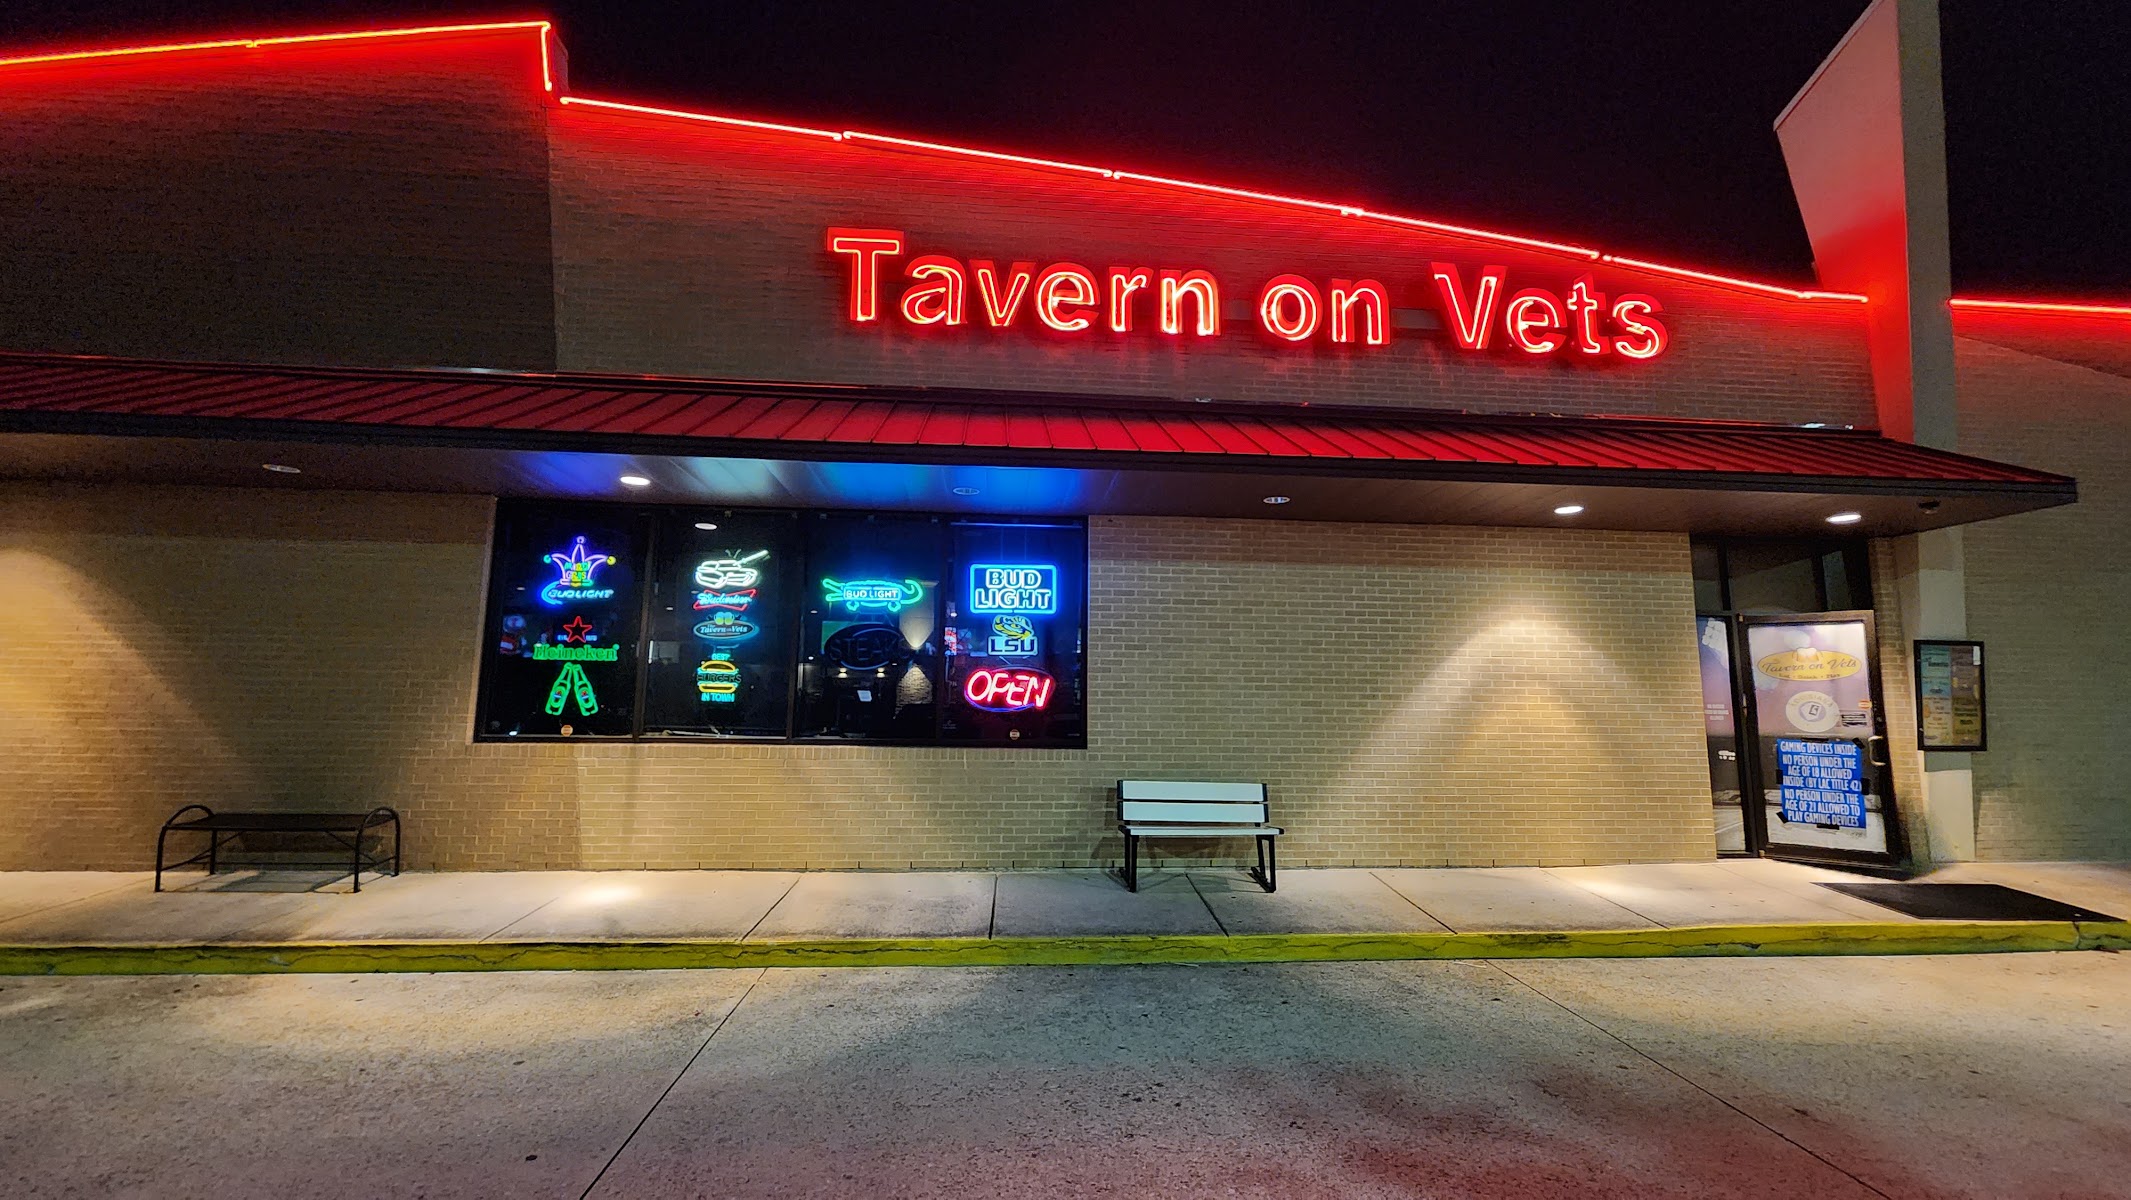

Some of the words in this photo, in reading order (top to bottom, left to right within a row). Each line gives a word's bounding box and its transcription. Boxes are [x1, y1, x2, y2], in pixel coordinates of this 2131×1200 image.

[826, 227, 1221, 336] Tavern
[1260, 273, 1392, 346] on
[1431, 262, 1669, 360] Vets
[985, 568, 1042, 589] BUD
[847, 590, 867, 598] BUD
[869, 590, 899, 598] LIGHT
[975, 588, 1051, 609] LIGHT
[533, 644, 618, 661] Heineken
[988, 636, 1038, 655] LSU
[712, 653, 731, 661] BEST
[1762, 661, 1805, 672] Tavern
[696, 673, 742, 683] BURGERS
[966, 670, 1050, 707] OPEN
[702, 692, 710, 701] IN
[711, 692, 735, 702] TOWN
[1780, 741, 1806, 752] GAMING
[1807, 742, 1833, 754] DEVICES
[1834, 744, 1857, 755] INSIDE
[1783, 754, 1792, 764] NO
[1793, 755, 1818, 766] PERSON
[1820, 756, 1842, 768] UNDER
[1843, 757, 1857, 769] THE
[1788, 765, 1800, 776] AGE
[1802, 766, 1811, 777] OF
[1812, 767, 1819, 777] 18
[1821, 768, 1852, 779] ALLOWED
[1783, 776, 1804, 787] INSIDE
[1818, 778, 1830, 789] LAC
[1830, 779, 1849, 790] TITLE
[1784, 788, 1794, 799] NO
[1795, 789, 1820, 801] PERSON
[1821, 791, 1845, 803] UNDER
[1845, 793, 1859, 804] THE
[1785, 799, 1798, 810] AGE
[1799, 800, 1808, 811] OF
[1809, 801, 1816, 812] 21
[1817, 802, 1850, 815] ALLOWED
[1850, 804, 1860, 816] TO
[1788, 810, 1803, 821] PLAY
[1804, 811, 1830, 825] GAMING
[1831, 814, 1860, 826] DEVICES
